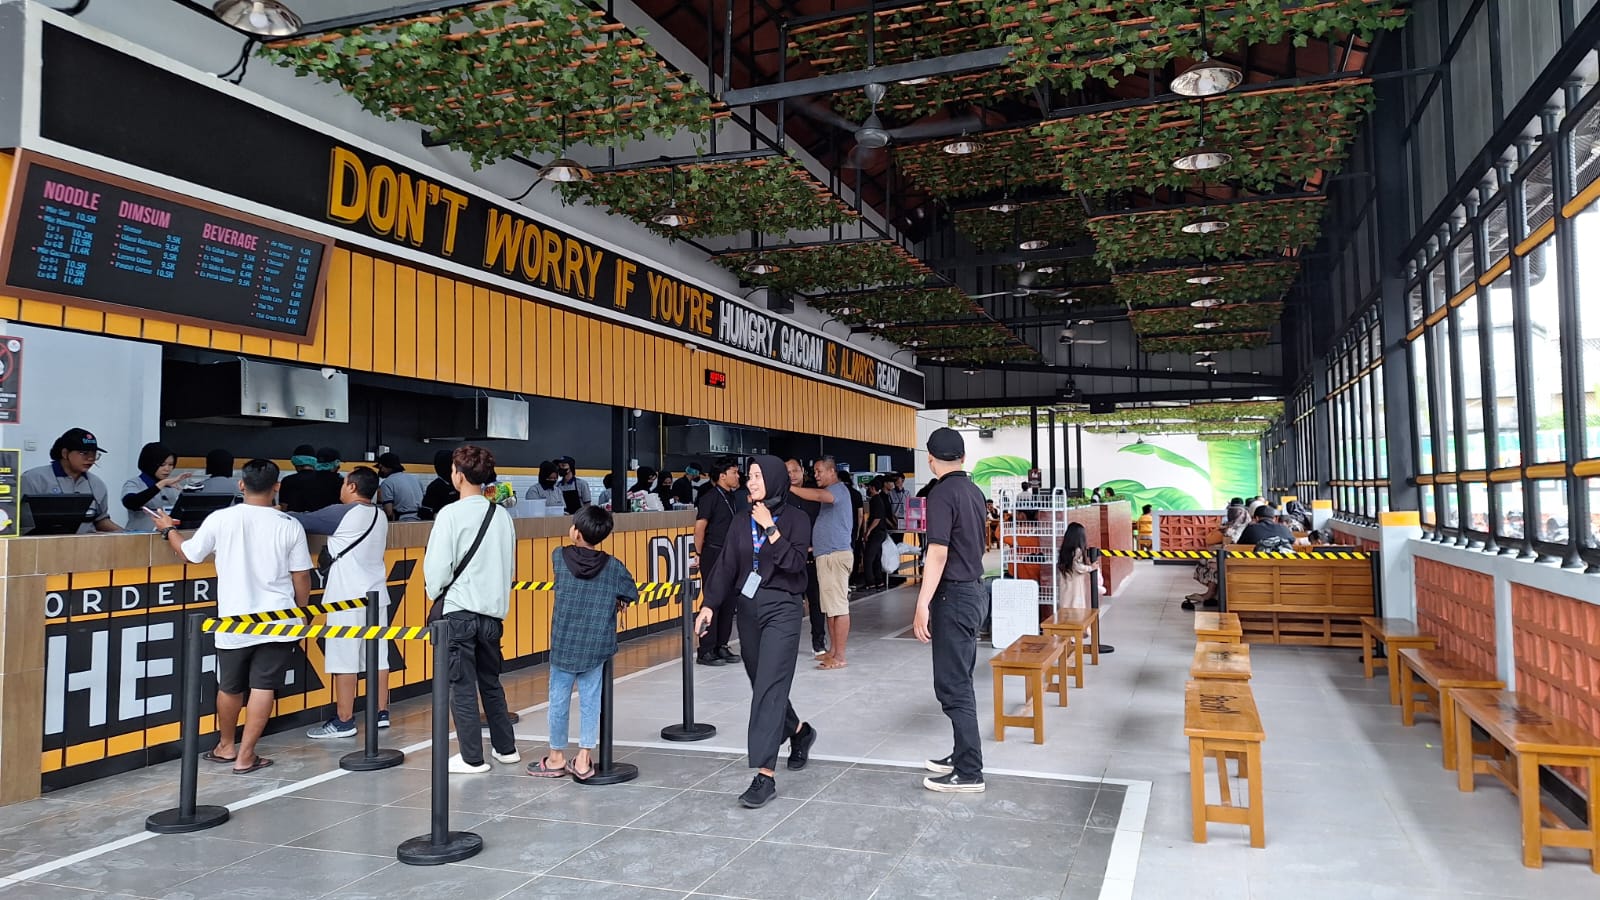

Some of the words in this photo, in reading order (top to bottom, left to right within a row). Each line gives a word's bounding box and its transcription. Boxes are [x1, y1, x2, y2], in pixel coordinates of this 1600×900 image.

[44, 181, 101, 210] NOODLE
[118, 200, 171, 228] DIMSUM
[202, 223, 259, 251] BEVERAGE
[327, 146, 468, 256] DON'T
[482, 207, 604, 301] WORRY
[613, 258, 637, 310] IF
[647, 270, 714, 337] YOU'RE
[718, 300, 777, 358] HUNGRY.
[780, 325, 823, 373] GACOAN
[827, 341, 837, 375] IS
[840, 347, 875, 386] ALWAYS
[877, 361, 901, 395] READY
[45, 579, 210, 618] ORDER
